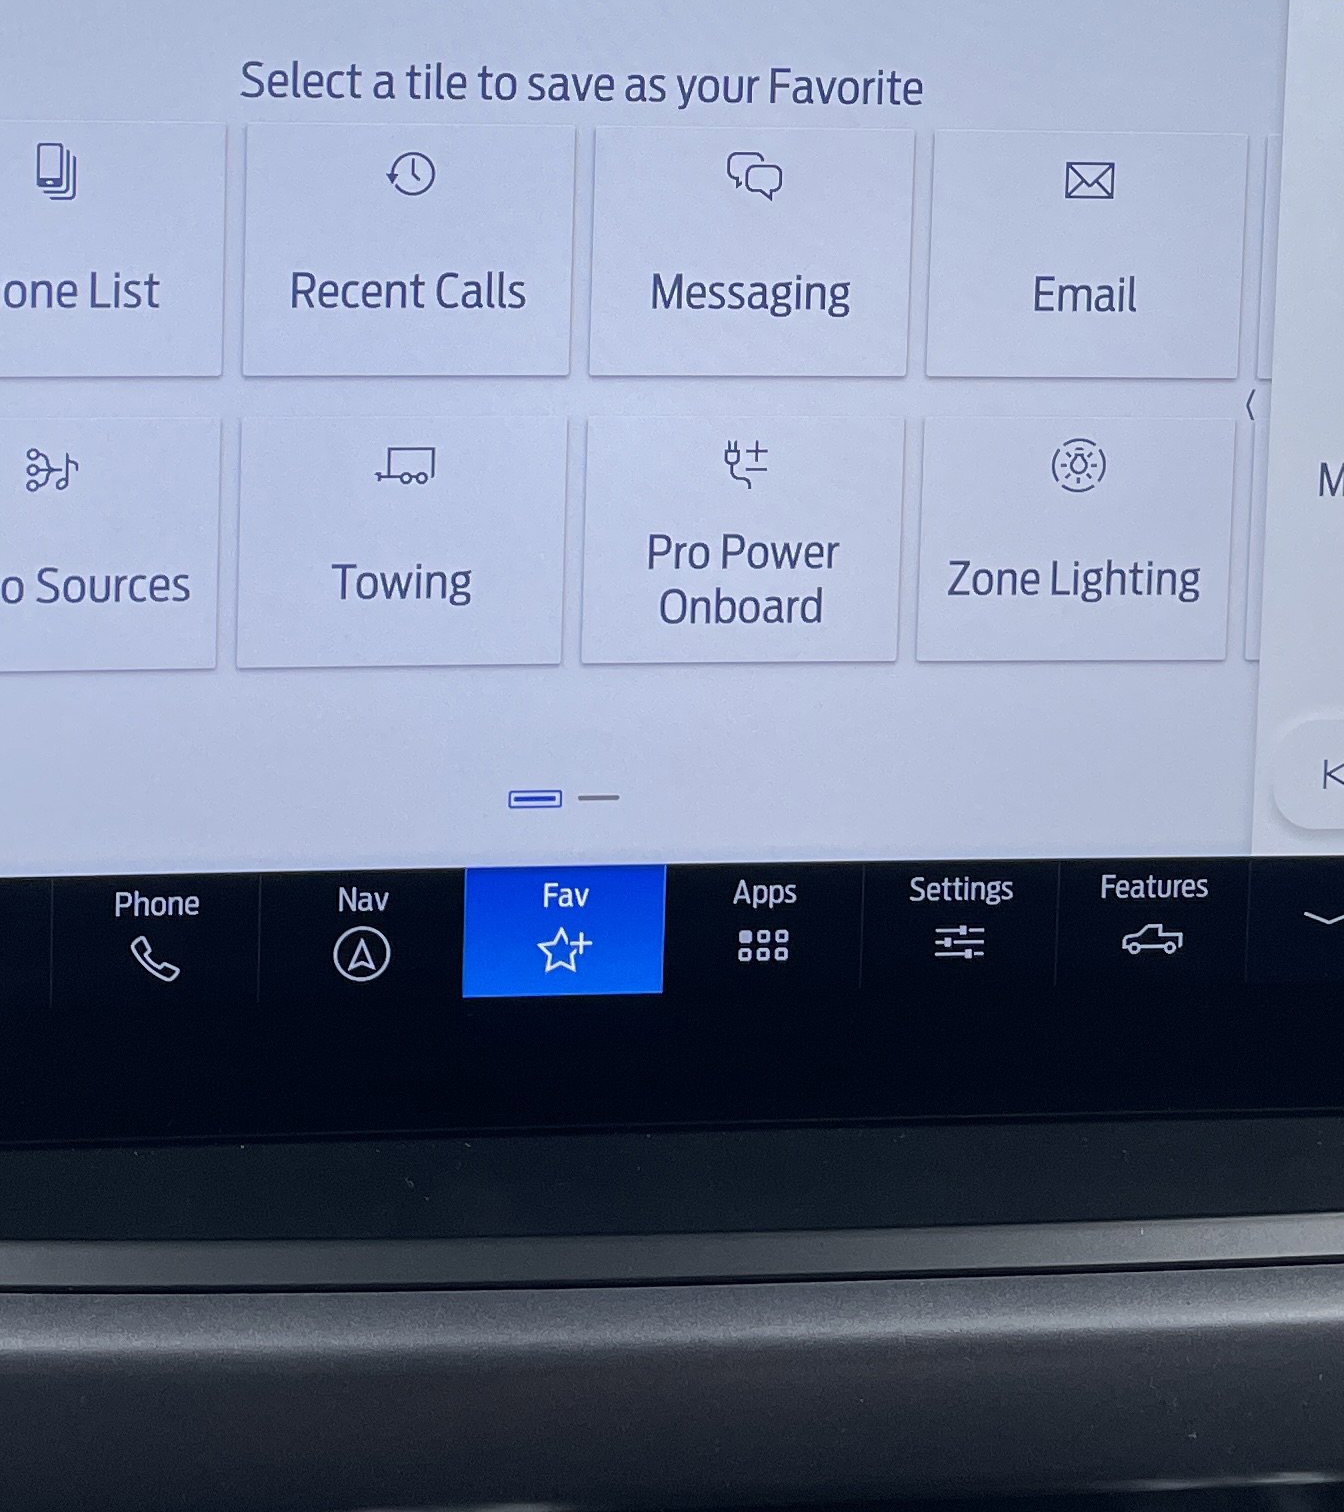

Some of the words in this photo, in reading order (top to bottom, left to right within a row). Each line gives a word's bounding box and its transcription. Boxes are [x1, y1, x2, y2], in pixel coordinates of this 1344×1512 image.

[239, 60, 363, 99] Select
[372, 71, 396, 100] a
[405, 61, 467, 100] tile
[477, 65, 517, 101] to
[527, 72, 615, 102] save
[624, 74, 666, 103] as
[676, 74, 761, 110] your
[769, 67, 923, 106] Favorite
[90, 271, 161, 309] List
[291, 271, 426, 309] Recent
[436, 270, 526, 309] Calls
[651, 272, 851, 318] Messaging
[1034, 275, 1137, 313] Email
[648, 533, 710, 570] Pro
[721, 533, 841, 570] Power
[35, 567, 190, 604] Sources
[331, 563, 472, 607] Towing
[947, 560, 1040, 596] Zone
[1051, 559, 1201, 603] Lighting
[660, 586, 823, 625] Onboard
[115, 889, 200, 917] Phone
[338, 886, 390, 912] Nav
[543, 882, 590, 908] Fav
[733, 879, 797, 910] Apps
[909, 876, 1014, 906] Settings
[1101, 874, 1209, 899] Features
